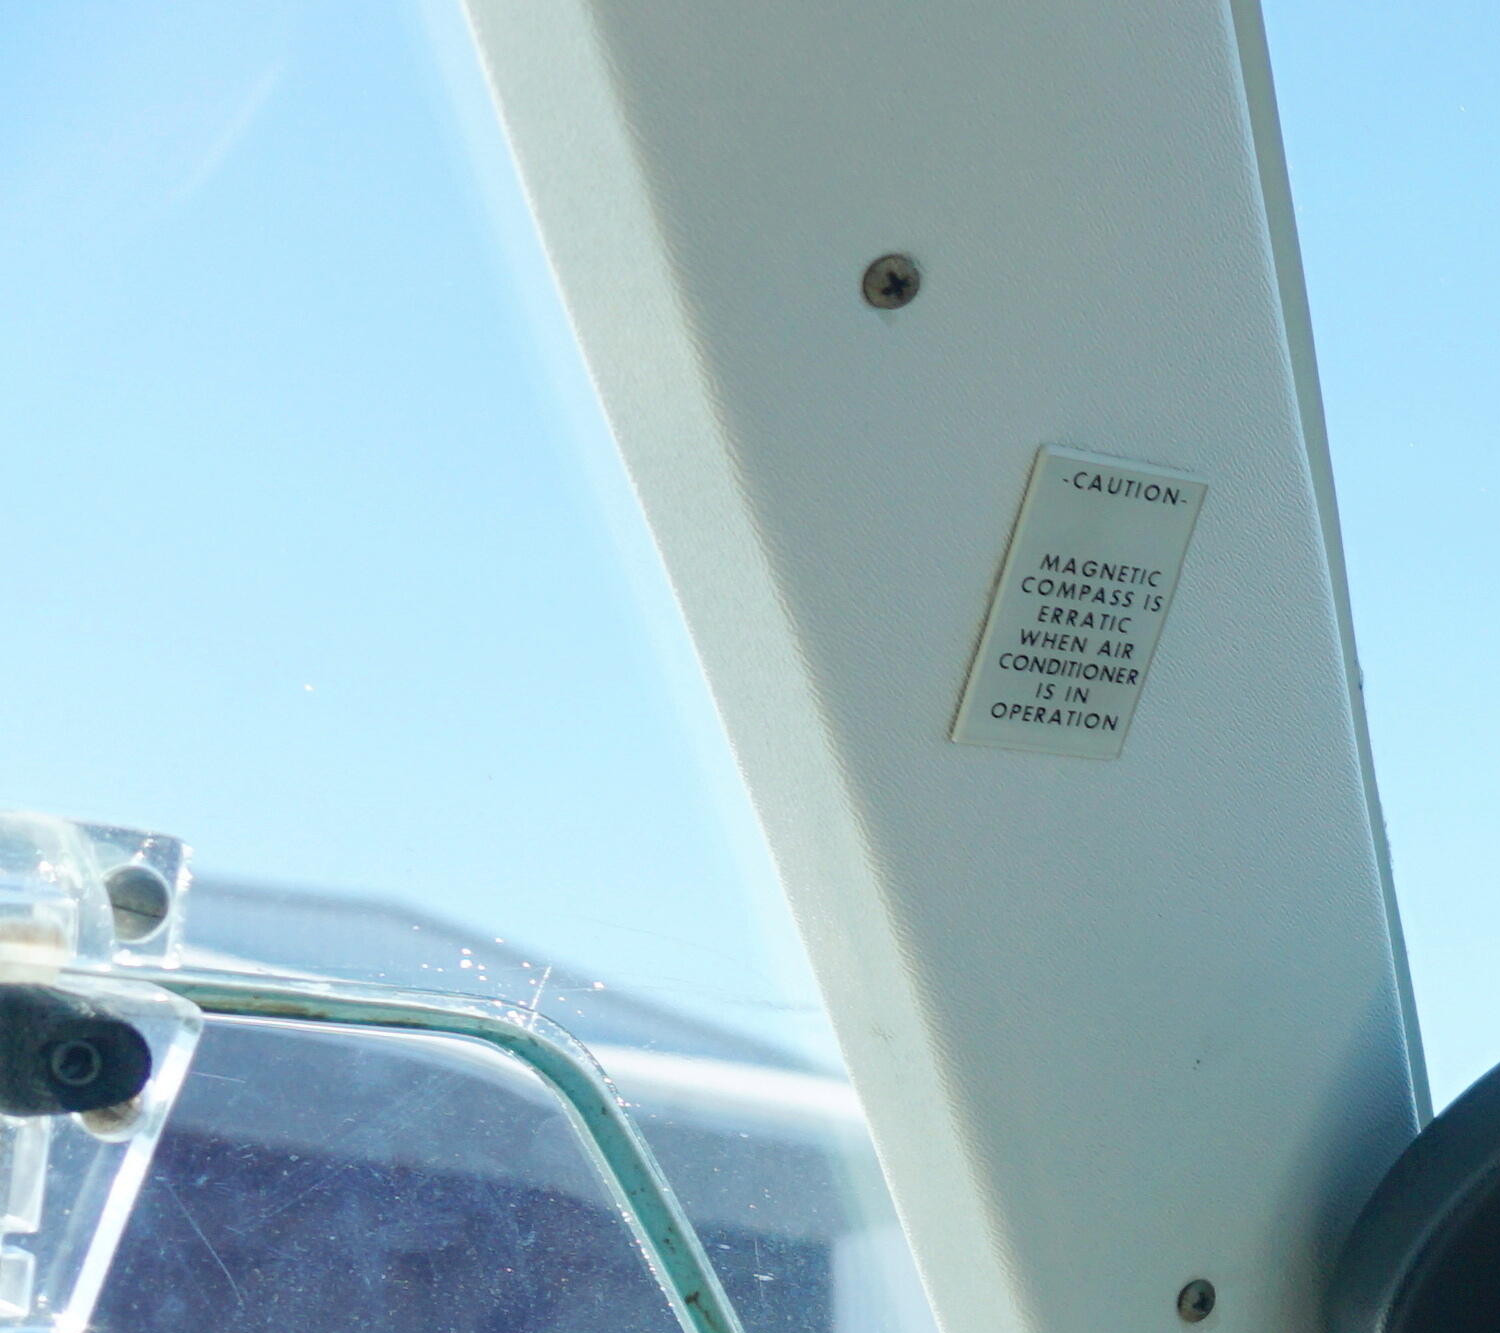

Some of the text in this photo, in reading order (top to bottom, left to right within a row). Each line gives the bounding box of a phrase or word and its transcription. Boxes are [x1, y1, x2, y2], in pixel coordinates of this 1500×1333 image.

[1041, 554, 1161, 587] MAGNETIC
[1021, 577, 1162, 611] COMPASS IS
[1038, 606, 1131, 633] ERRATIC
[1020, 629, 1134, 659] WHEN AIR
[999, 653, 1139, 685] CONDITIONER
[1035, 683, 1089, 703] IS IN
[991, 702, 1118, 730] OPERATION
